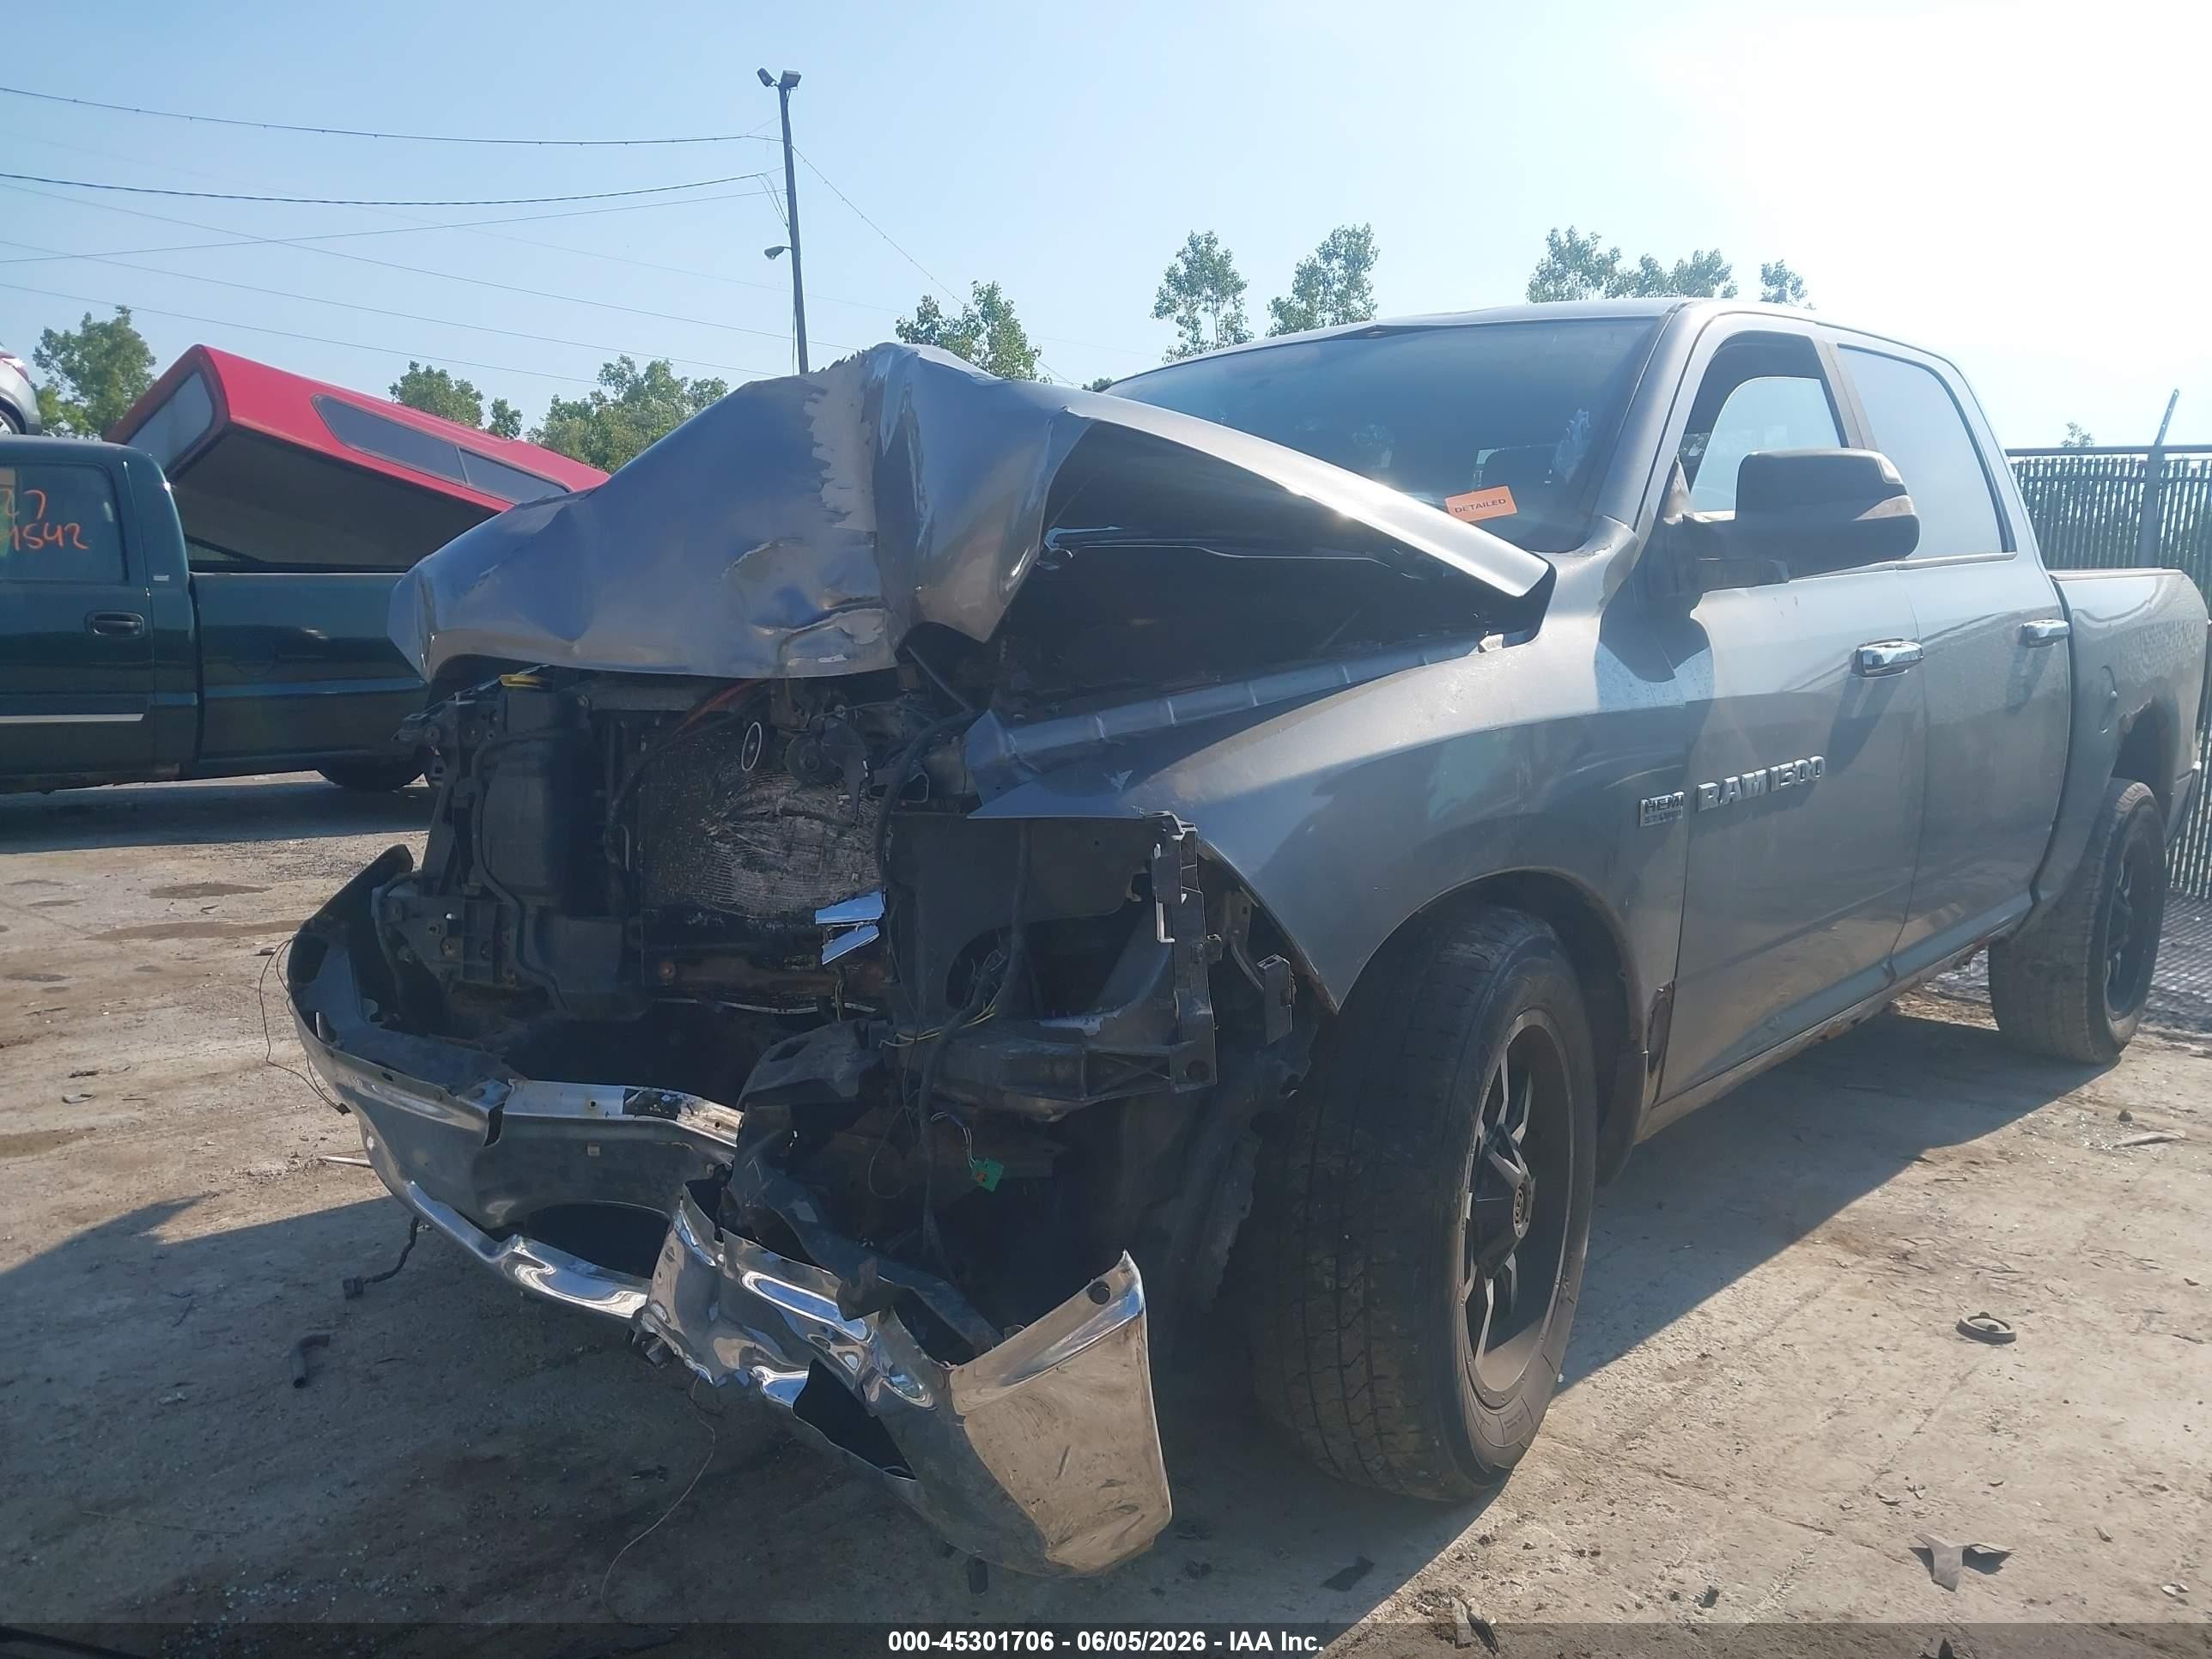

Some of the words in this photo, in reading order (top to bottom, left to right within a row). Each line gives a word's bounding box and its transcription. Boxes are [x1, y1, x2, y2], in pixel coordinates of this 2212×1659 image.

[1454, 497, 1507, 514] DETAILED
[1697, 769, 1767, 811] RAM
[1770, 755, 1826, 792] 1500
[1641, 791, 1684, 813] HEMI
